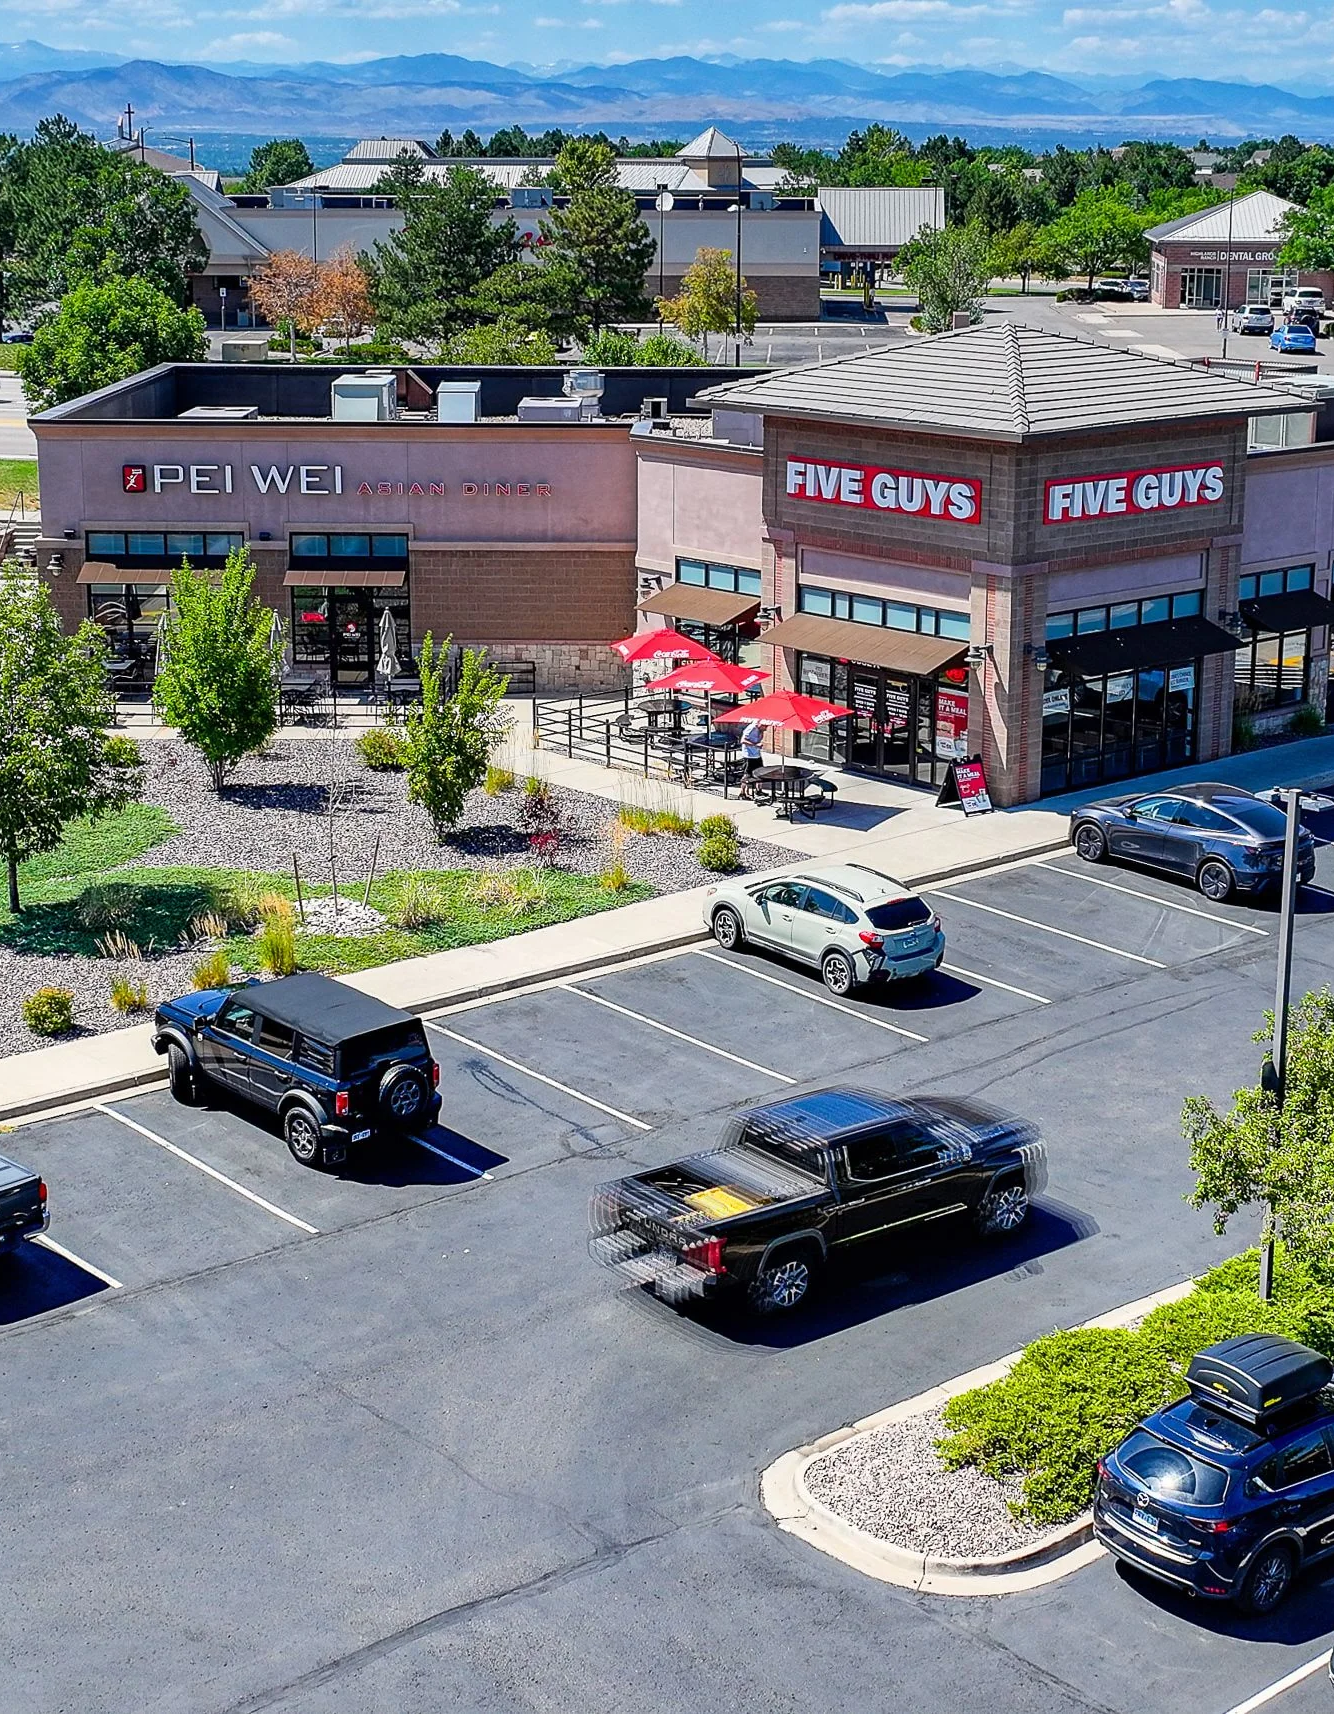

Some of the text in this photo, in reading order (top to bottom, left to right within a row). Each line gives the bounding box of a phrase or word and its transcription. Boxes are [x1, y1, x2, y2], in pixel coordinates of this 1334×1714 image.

[1220, 251, 1254, 261] DENTAL
[153, 464, 343, 495] PEI WEI
[356, 481, 552, 497] ASIAN DINER
[786, 461, 976, 519] FIVE GUYS
[1049, 466, 1225, 521] FIVE GUYS
[938, 698, 956, 707] MAKE
[950, 706, 968, 716] MEAL
